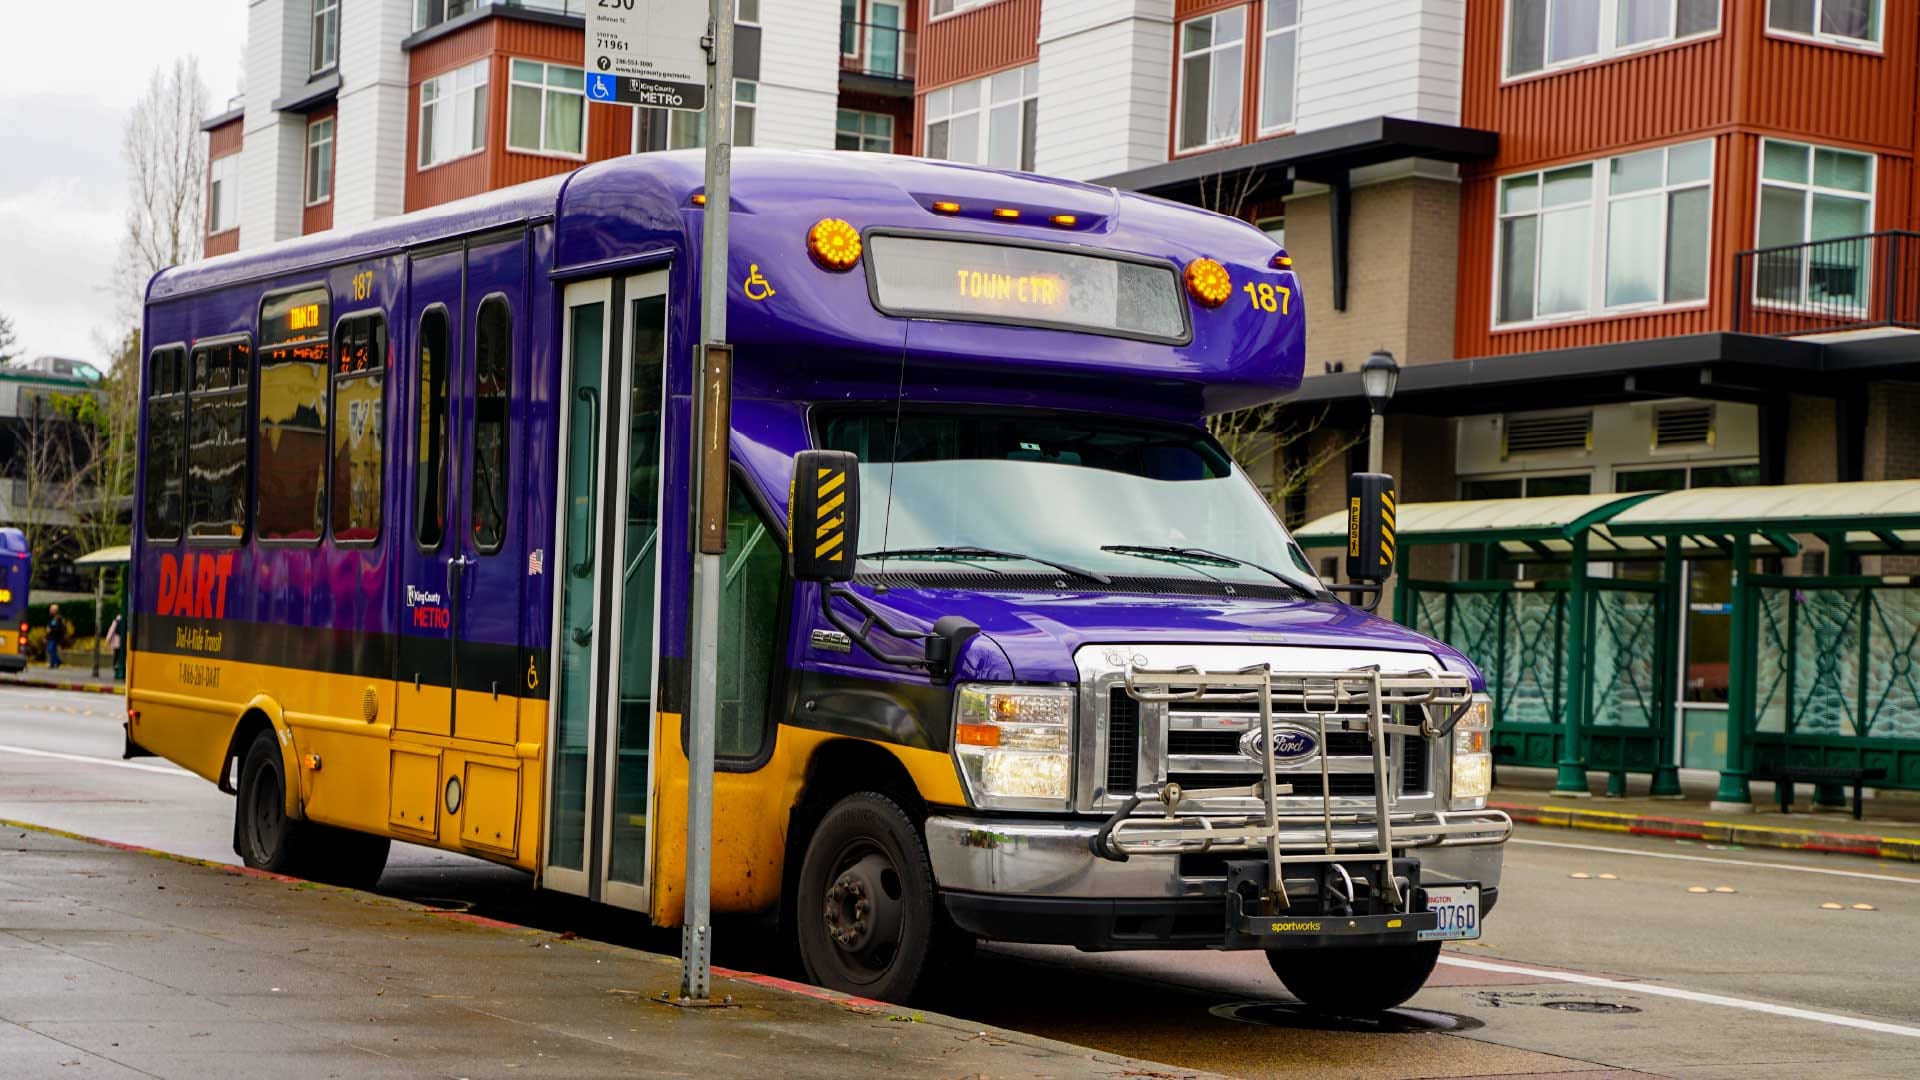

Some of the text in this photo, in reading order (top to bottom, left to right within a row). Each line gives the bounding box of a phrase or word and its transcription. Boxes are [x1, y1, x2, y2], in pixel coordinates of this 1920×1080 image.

[597, 38, 629, 51] 71961
[640, 82, 675, 95] King County
[640, 91, 683, 106] METRO
[353, 271, 373, 302] 187
[957, 269, 1011, 302] TOWN
[1243, 281, 1291, 315] 187
[1351, 506, 1359, 539] PEDS
[157, 553, 233, 619] DART
[414, 590, 440, 605] King County
[413, 607, 450, 629] METRO
[1273, 734, 1305, 752] Ford
[1426, 896, 1452, 904] INGTON
[1271, 921, 1321, 933] sportworks
[1429, 904, 1476, 930] 076D
